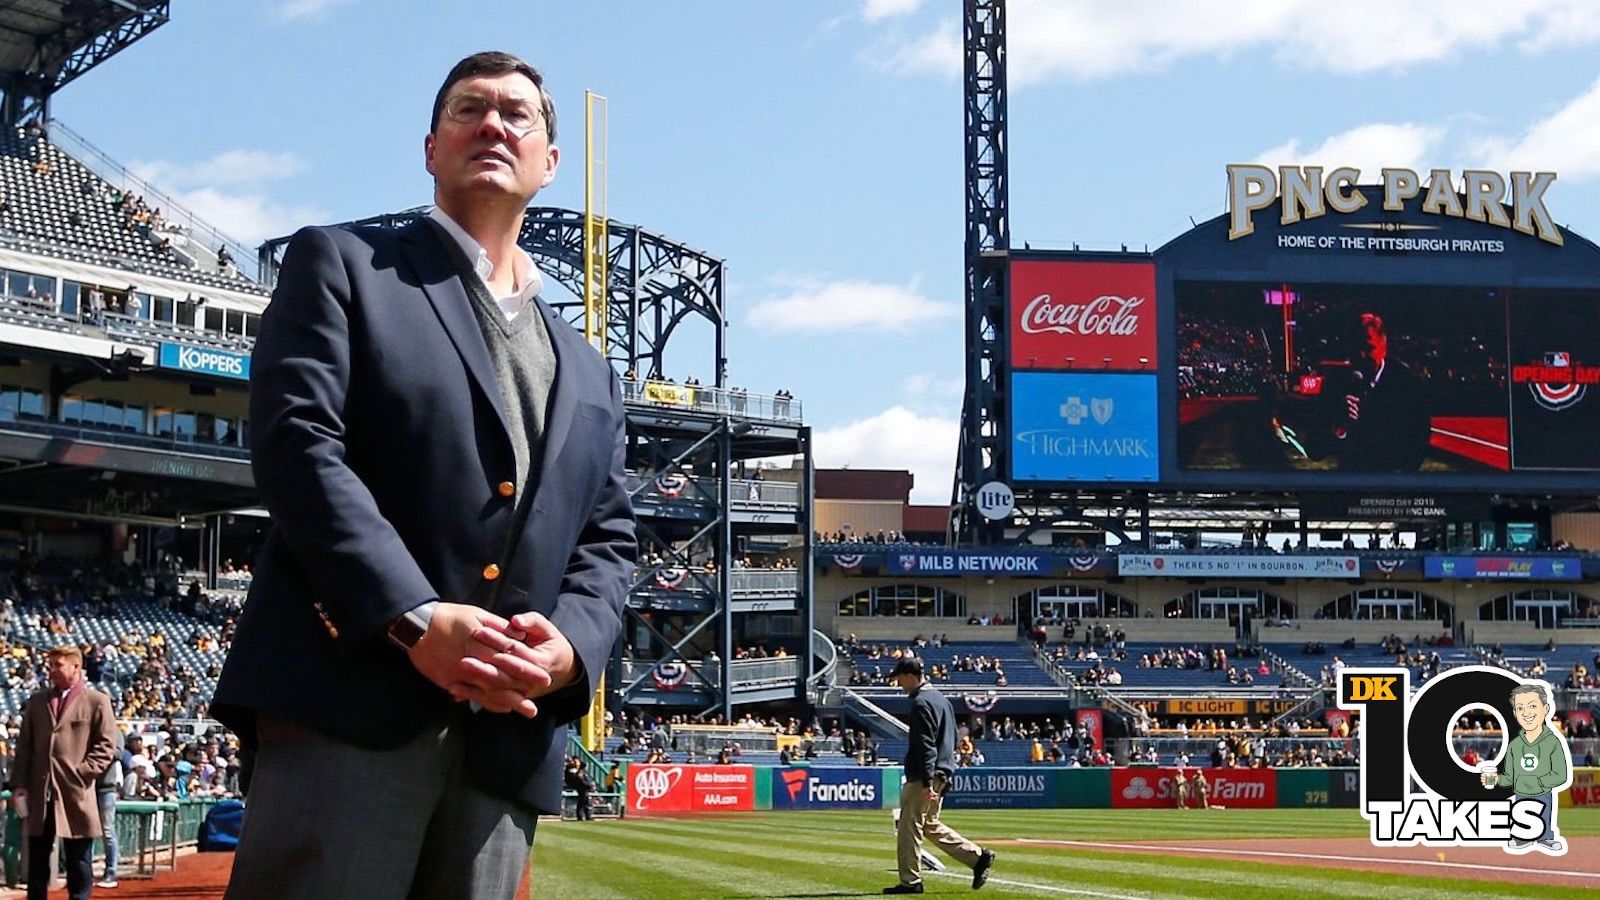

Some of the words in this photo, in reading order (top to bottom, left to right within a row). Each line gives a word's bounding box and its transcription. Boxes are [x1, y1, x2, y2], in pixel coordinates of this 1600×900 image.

[1227, 164, 1368, 240] PNC
[1381, 168, 1564, 246] PARK
[1278, 235, 1315, 248] HOME
[1318, 236, 1336, 248] OF
[1339, 237, 1366, 249] THE
[1368, 238, 1449, 251] PITTSBURGH
[1452, 239, 1504, 252] PIRATES
[179, 346, 243, 374] KOPPERS
[1017, 429, 1149, 457] HIGHMARK
[982, 491, 1011, 510] Lite
[1423, 507, 1447, 516] BANK
[919, 555, 953, 570] MLB
[958, 556, 1039, 571] NETWORK
[1173, 561, 1213, 570] THERE'S
[1179, 702, 1195, 713] IC
[1198, 702, 1236, 713] LIGHT
[637, 769, 668, 795] AAA
[694, 772, 711, 783] Auto
[713, 772, 747, 783] Insurance
[988, 775, 1045, 791] BORDAS
[809, 778, 875, 801] Fanatics
[1213, 778, 1265, 799] Farm
[704, 794, 738, 805] AAA.com
